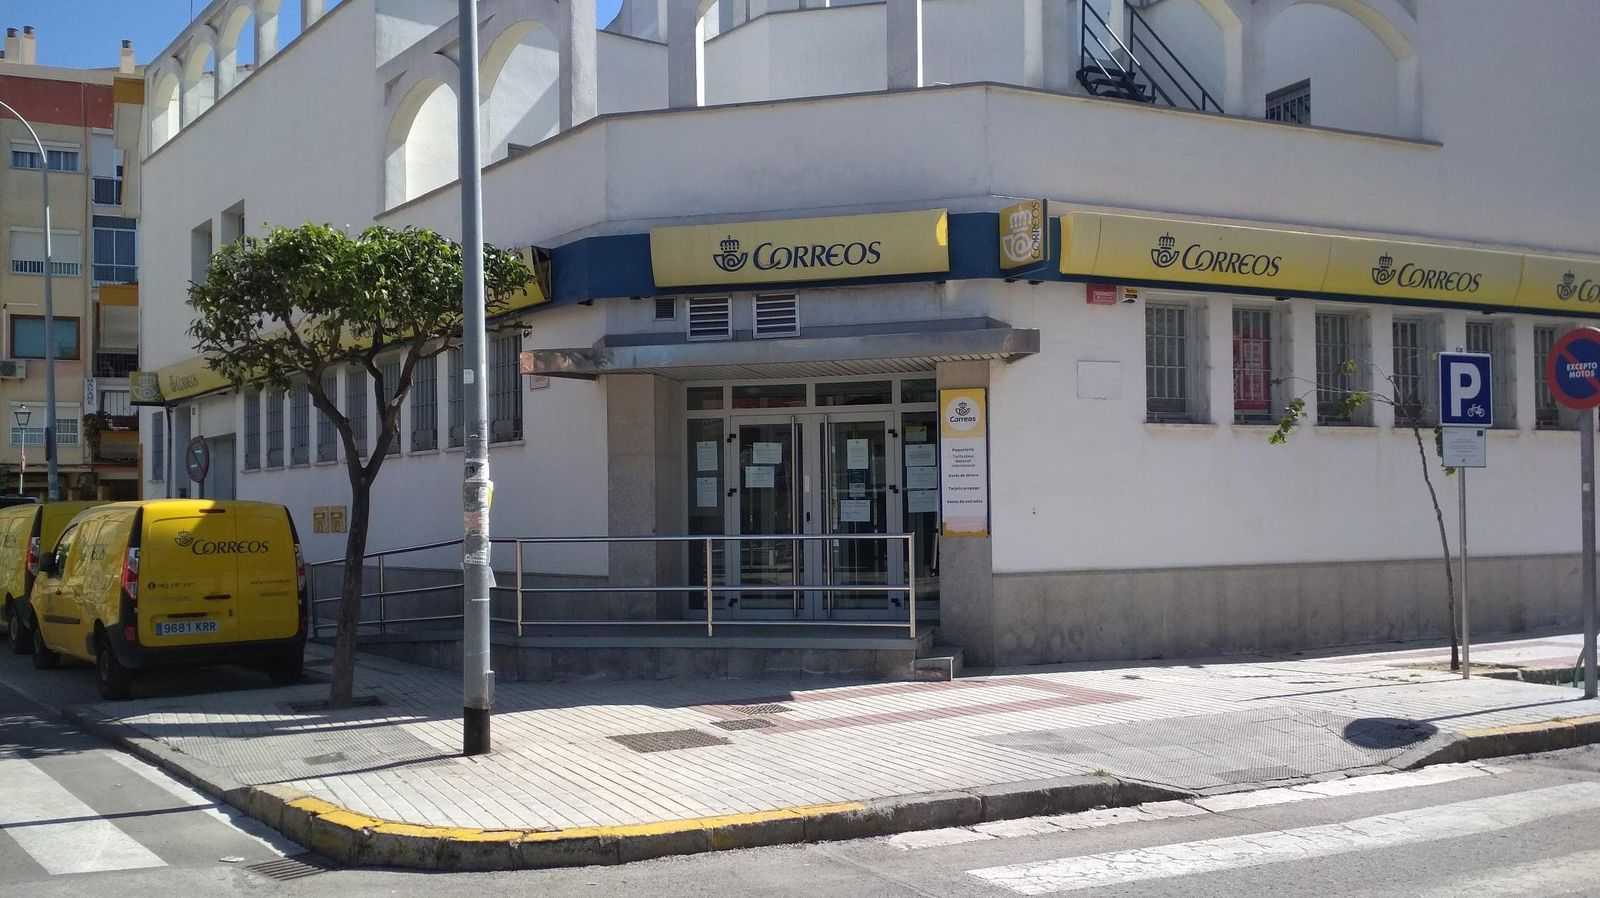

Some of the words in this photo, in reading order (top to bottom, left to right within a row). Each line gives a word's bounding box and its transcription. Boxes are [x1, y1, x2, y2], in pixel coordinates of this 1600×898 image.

[1031, 200, 1040, 258] CORREOS
[753, 241, 881, 270] CORREOS
[1182, 244, 1282, 276] CORREOS
[1397, 263, 1482, 292] CORREOS
[1566, 362, 1597, 371] EXCEPTO
[1569, 370, 1595, 378] MOTOS
[1450, 362, 1482, 417] P
[192, 540, 269, 555] CORREOS
[163, 622, 191, 633] 9681
[195, 621, 216, 631] KRR
